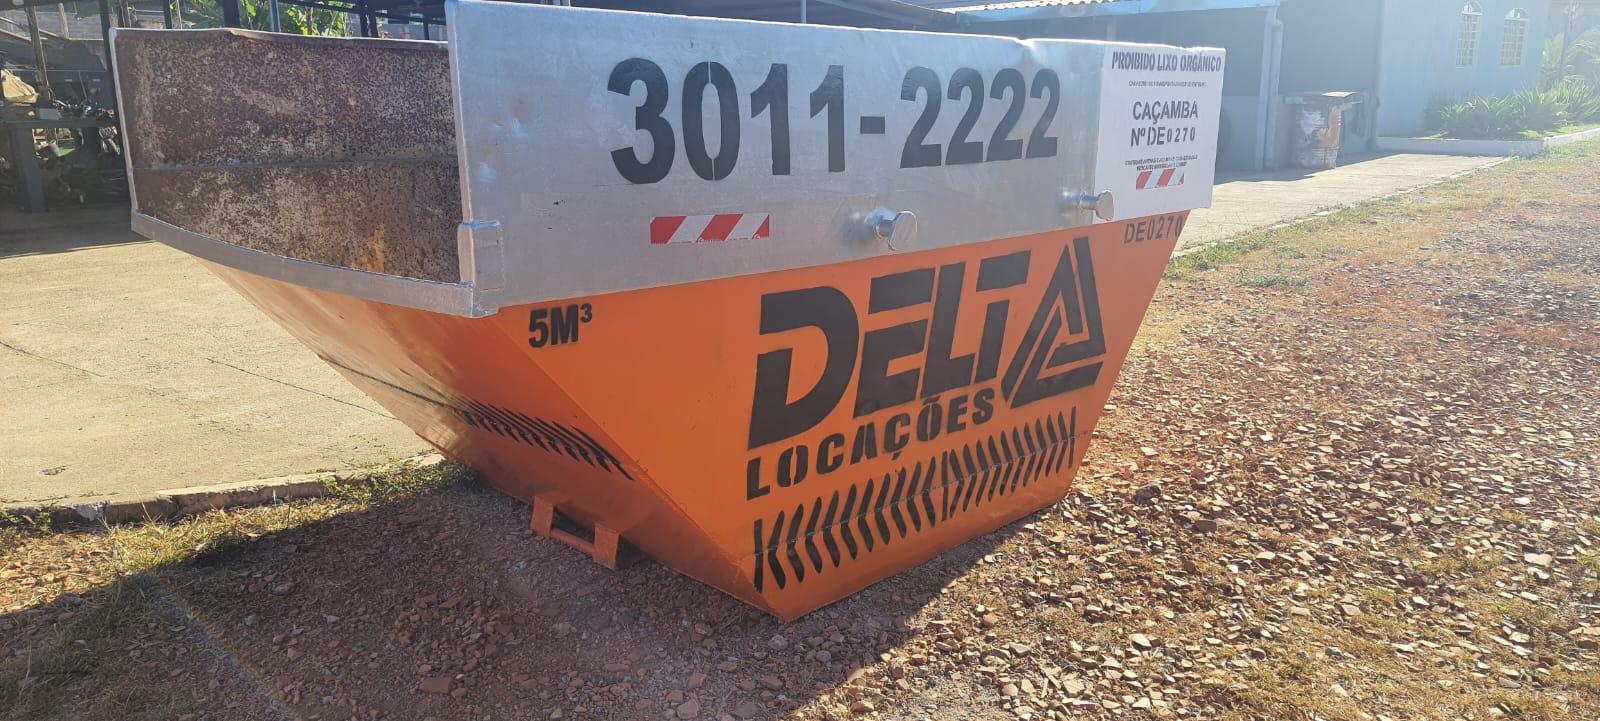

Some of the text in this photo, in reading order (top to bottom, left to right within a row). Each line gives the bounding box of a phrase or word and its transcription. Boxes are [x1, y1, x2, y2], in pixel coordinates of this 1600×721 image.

[1112, 51, 1221, 72] PROIBIDO LIXO ORGÂNICO
[607, 57, 1060, 184] 3011-2222
[1132, 100, 1199, 124] CAÇAMBA
[1124, 215, 1184, 244] DE0270
[747, 236, 1107, 451] DELTA
[746, 388, 996, 500] LOCAÇÕES
